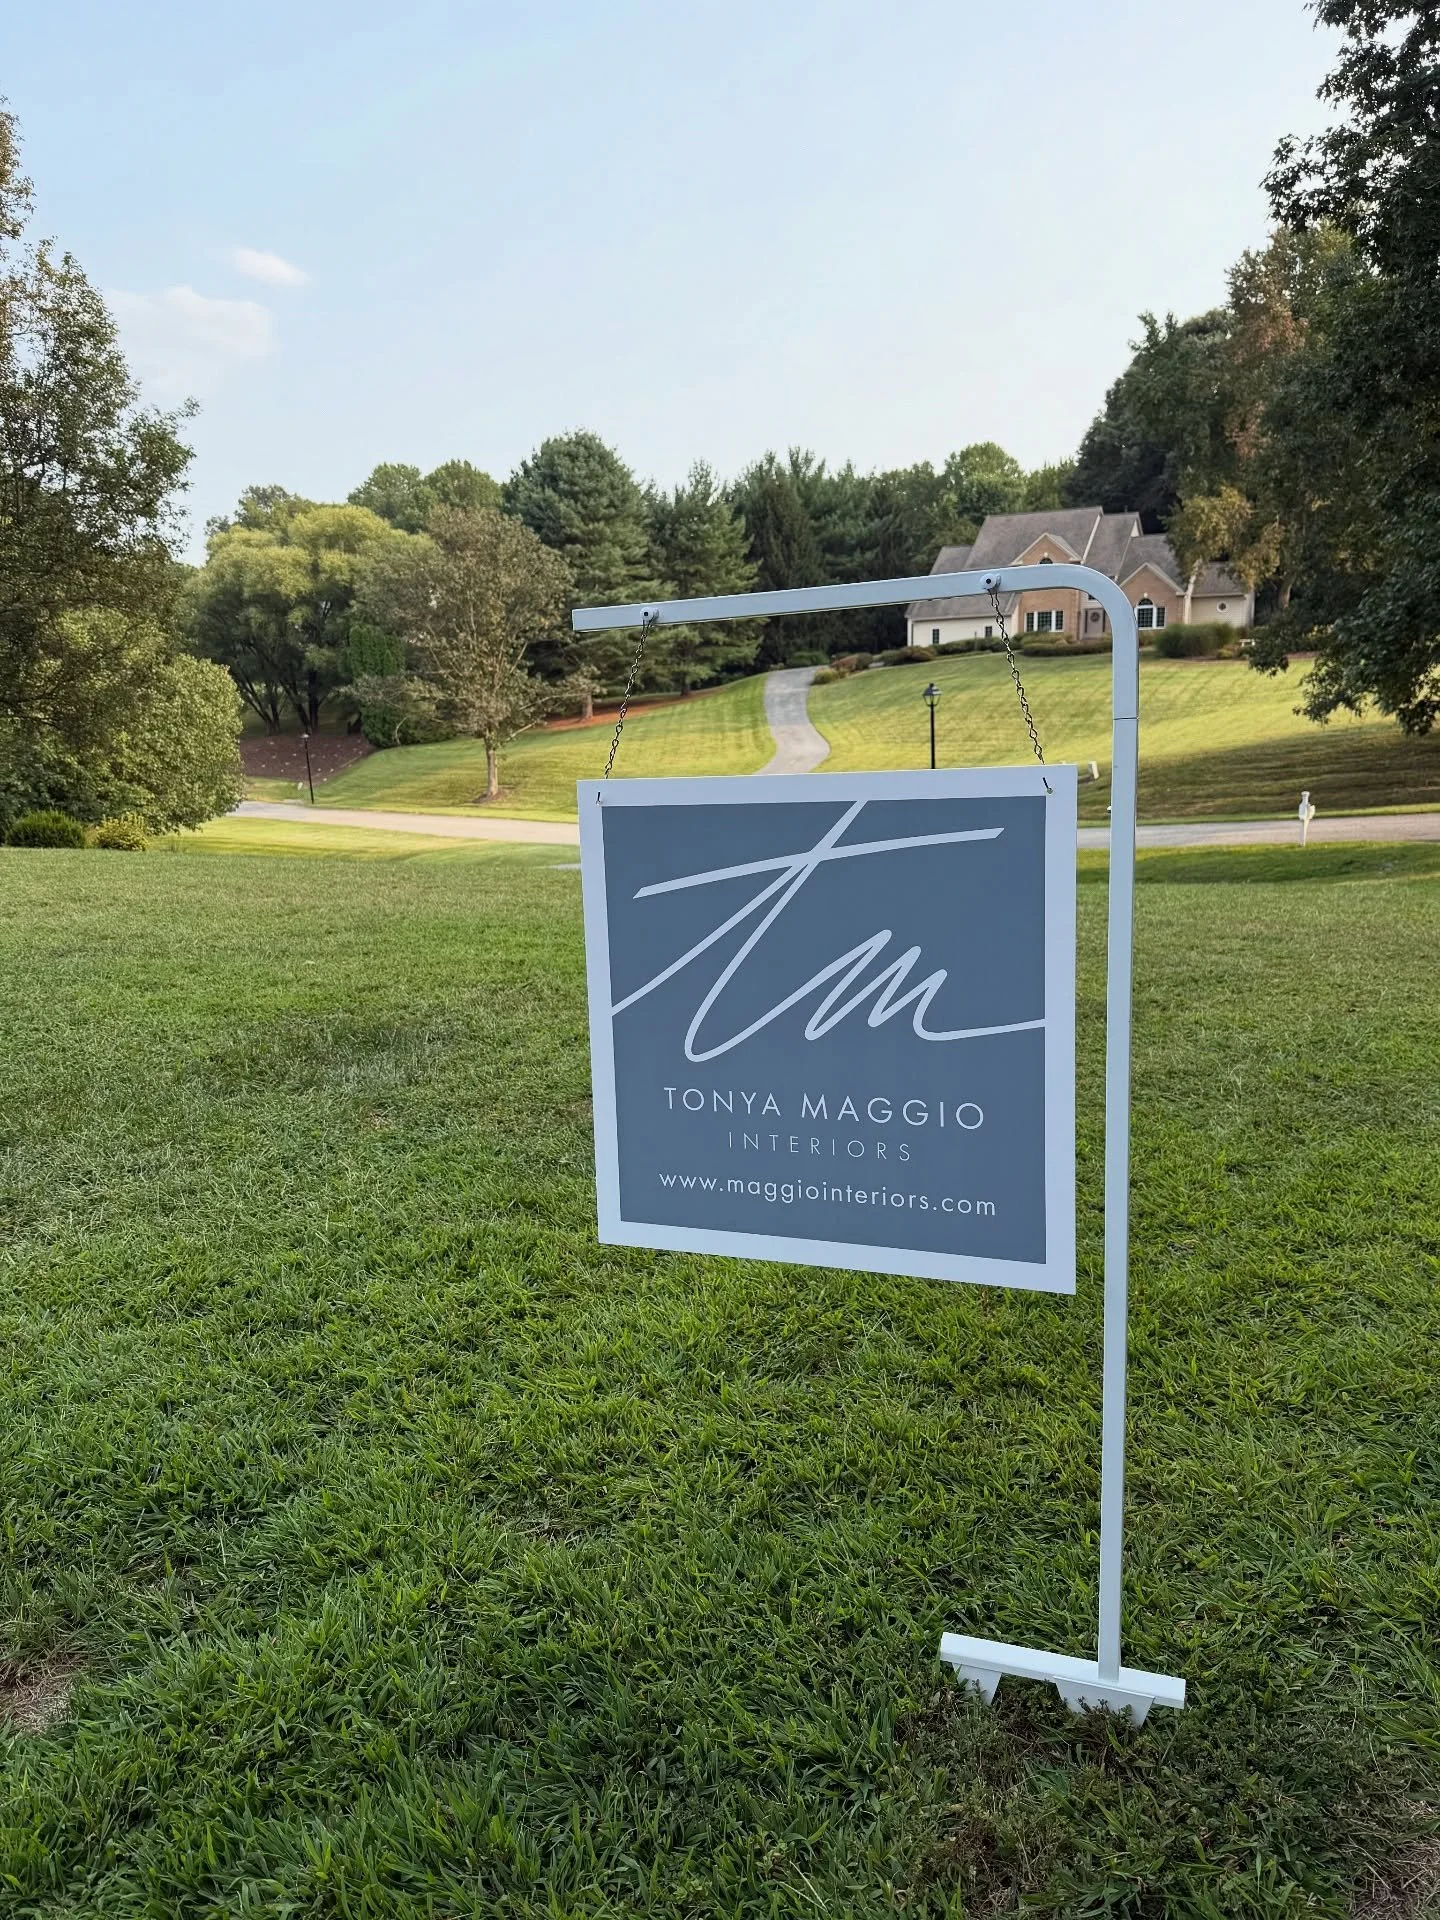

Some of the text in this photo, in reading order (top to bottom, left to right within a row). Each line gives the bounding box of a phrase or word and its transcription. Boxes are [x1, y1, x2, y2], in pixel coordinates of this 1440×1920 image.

[663, 1086, 985, 1131] TONYA MAGGIO
[728, 1130, 912, 1163] INTERIORS
[658, 1172, 997, 1217] www.maggiointeriors.com
